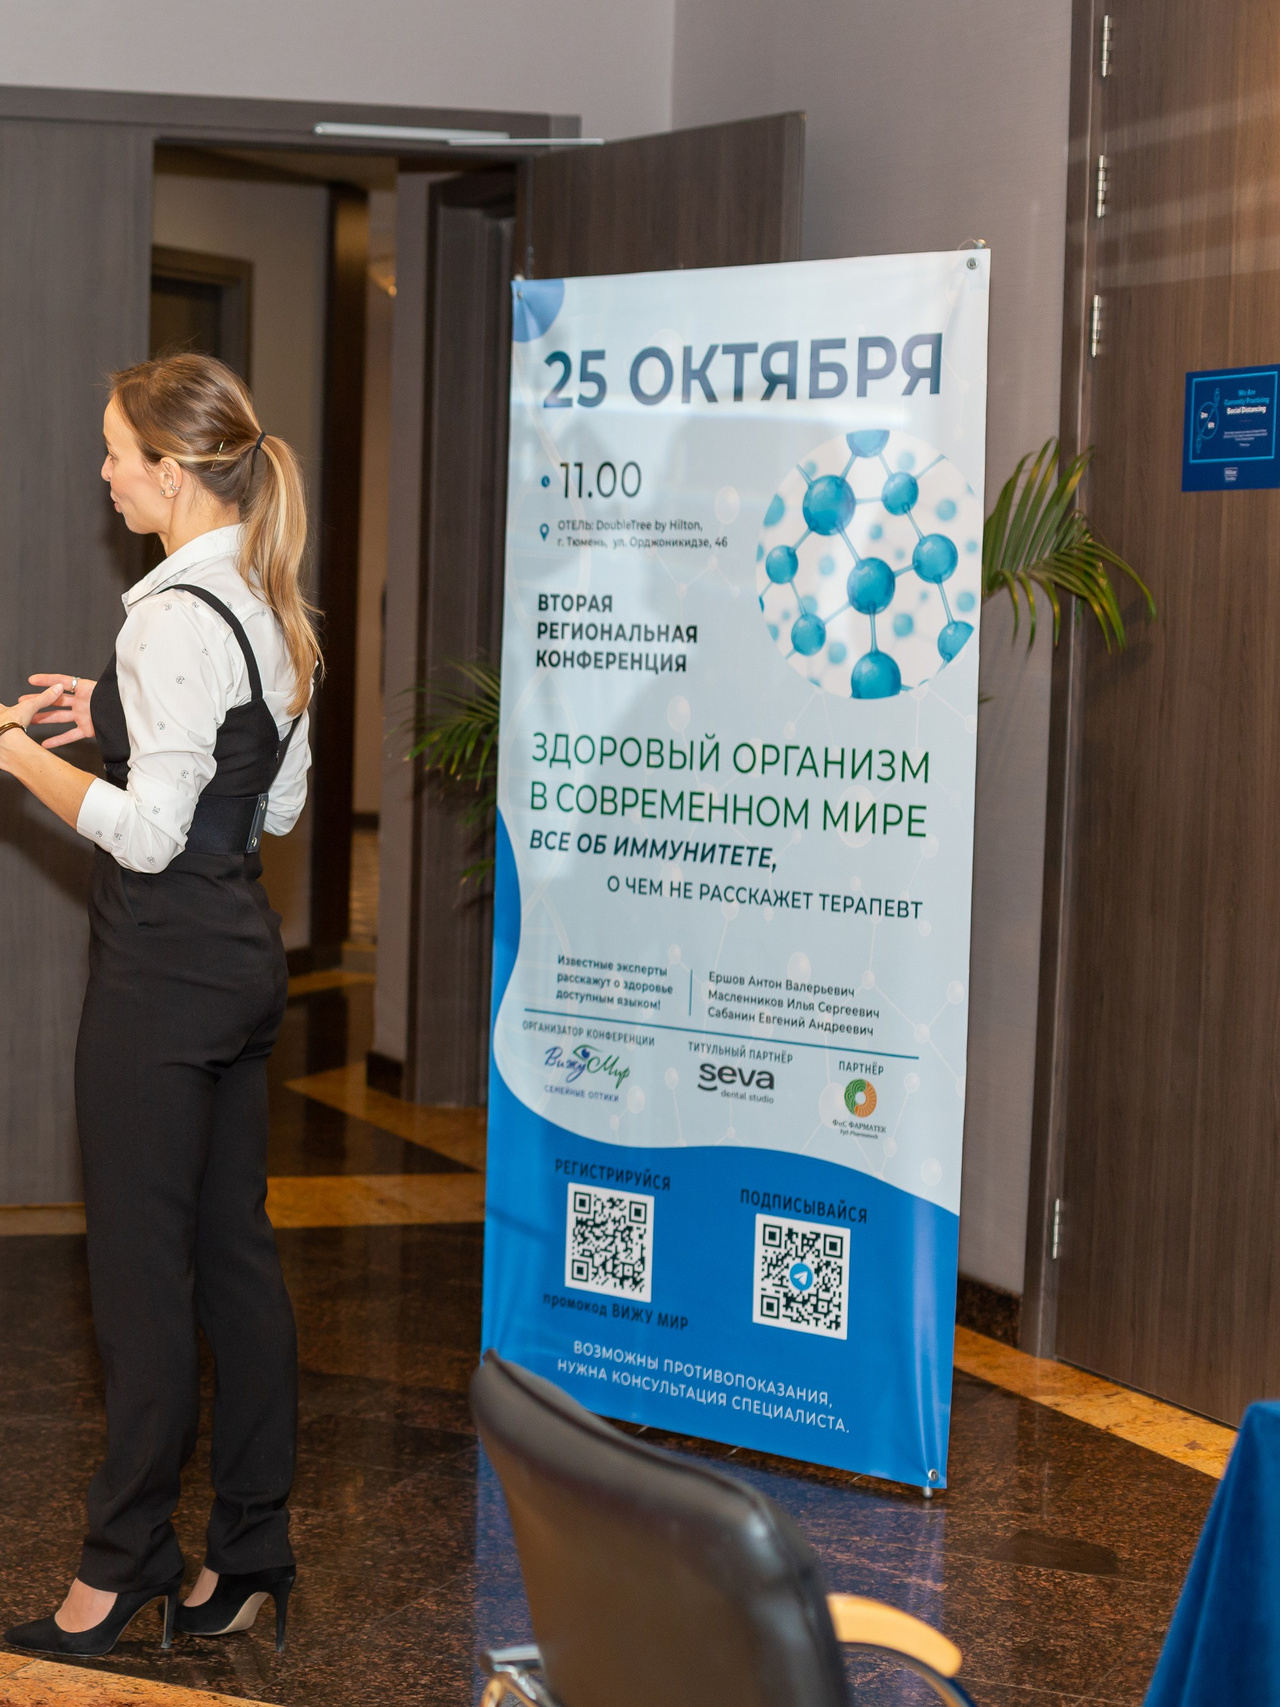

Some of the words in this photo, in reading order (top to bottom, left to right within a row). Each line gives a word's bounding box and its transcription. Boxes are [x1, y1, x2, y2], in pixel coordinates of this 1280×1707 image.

[543, 350, 607, 408] 25
[630, 332, 943, 404] ОКТЯБРЯ
[559, 461, 642, 499] 11.00
[558, 520, 593, 531] ОТЕЛЬ:
[597, 520, 652, 531] DoubleTree
[655, 520, 667, 532] by
[670, 519, 703, 532] Hilton,
[557, 538, 565, 547] г.
[567, 536, 608, 548] Тюмень,
[613, 538, 627, 549] ул.
[630, 536, 712, 549] Орджоникидзе,
[715, 536, 728, 547] 46
[538, 593, 613, 612] ВТОРАЯ
[537, 622, 698, 643] РЕГИОНАЛЬНАЯ
[536, 650, 687, 675] КОНФЕРЕНЦИЯ
[531, 732, 721, 772] ЗДОРОВЫЙ
[732, 741, 930, 784] ОРГАНИЗМ
[530, 782, 548, 811] В
[557, 784, 809, 830] СОВРЕМЕННОМ
[822, 799, 927, 838] МИРЕ
[530, 830, 570, 851] ВСЕ
[577, 833, 607, 855] ОБ
[614, 835, 778, 874] ИММУНИТЕТЕ,
[607, 876, 620, 892] О
[625, 877, 663, 897] ЧЕМ
[669, 881, 693, 900] НЕ
[699, 884, 813, 910] РАССКАЖЕТ
[820, 893, 923, 919] ТЕРАПЕВТ
[558, 955, 614, 971] Известные
[617, 961, 667, 977] эксперты
[557, 973, 611, 991] расскажут
[614, 980, 620, 988] о
[623, 980, 673, 995] здоровье
[709, 971, 745, 989] Ершов
[748, 976, 782, 990] Антон
[785, 979, 855, 998] Валерьевич
[556, 989, 613, 1005] доступным
[617, 997, 661, 1011] языком!
[708, 989, 783, 1008] Масленников
[787, 997, 815, 1011] Илья
[818, 1001, 880, 1019] Сергеевич
[522, 1020, 583, 1037] ОРГАНИЗАТОР
[587, 1028, 655, 1046] КОНФЕРЕНЦИИ
[708, 1006, 756, 1023] Сабанин
[758, 1011, 805, 1028] Евгений
[809, 1017, 873, 1037] Андреевич
[688, 1041, 746, 1059] ТИТУЛЬНЫЙ
[749, 1049, 793, 1065] ПАРТНЁР
[699, 1062, 775, 1090] seva
[839, 1060, 884, 1076] ПАРТНЁР
[544, 1084, 585, 1098] СЕМЕЙНЫЕ
[589, 1091, 619, 1102] ОПТИКИ
[721, 1089, 746, 1100] dental
[749, 1093, 774, 1104] studio
[849, 1121, 886, 1133] ФАРМАТЕК
[555, 1158, 670, 1192] РЕГИСТРИРУЙСЯ
[740, 1189, 868, 1225] ПОДПИСЫВАЙСЯ
[543, 1293, 608, 1318] промокод
[612, 1302, 653, 1325] ВИЖУ
[657, 1310, 688, 1331] МИР
[574, 1341, 658, 1371] ВОЗМОЖНЫ
[664, 1360, 833, 1408] ПРОТИВОПОКАЗАНИЯ,
[558, 1358, 607, 1382] НУЖНА
[612, 1369, 727, 1406] КОНСУЛЬТАЦИЯ
[732, 1395, 850, 1433] СПЕЦИАЛИСТА.
